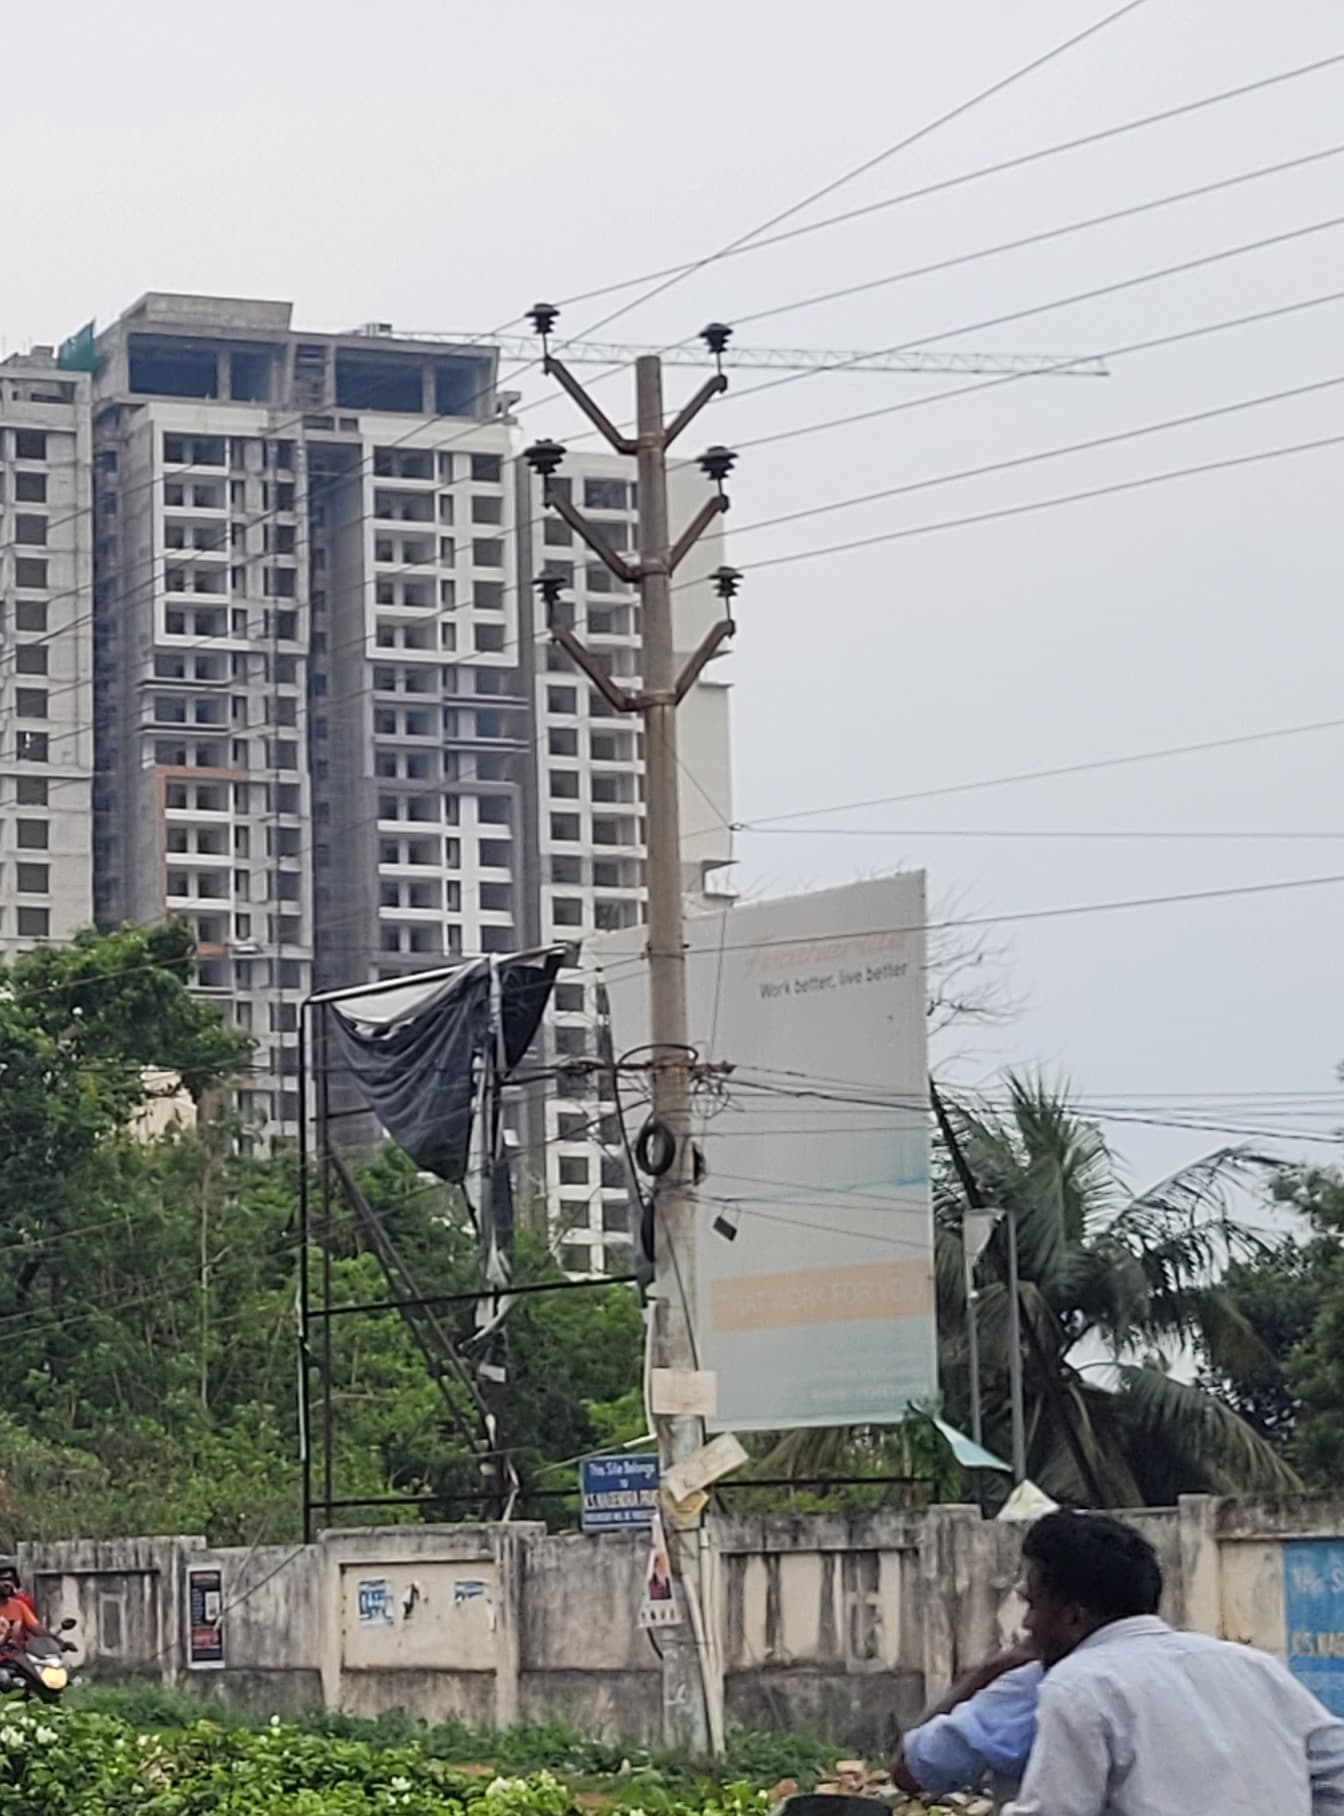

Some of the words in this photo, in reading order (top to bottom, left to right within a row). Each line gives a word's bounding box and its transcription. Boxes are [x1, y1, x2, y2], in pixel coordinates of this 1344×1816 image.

[760, 980, 790, 998] Work
[840, 968, 862, 986] live
[866, 962, 908, 982] better
